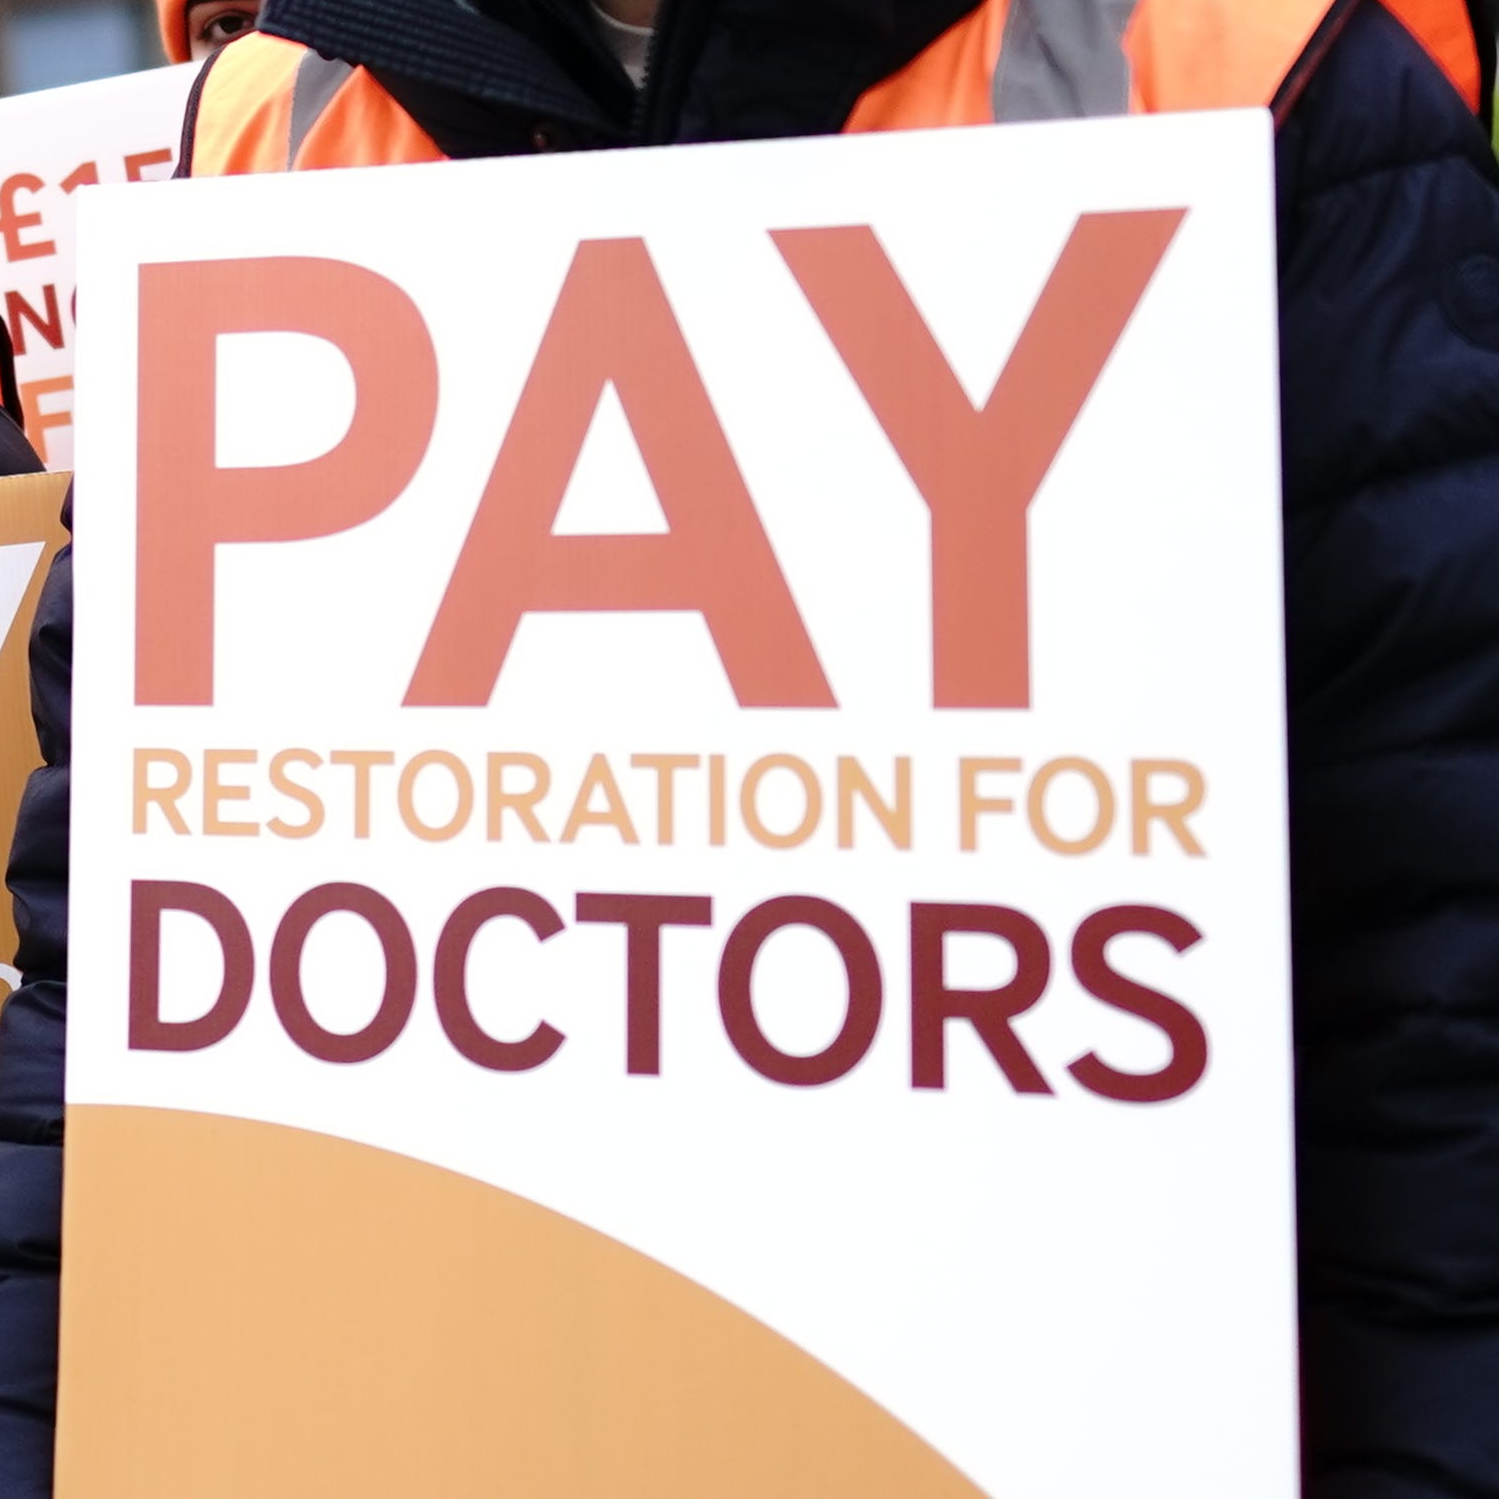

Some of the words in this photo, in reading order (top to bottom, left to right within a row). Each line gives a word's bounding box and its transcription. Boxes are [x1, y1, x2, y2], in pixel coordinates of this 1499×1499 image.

[134, 205, 1190, 710] PAY
[130, 747, 913, 852] RESTORATION
[958, 755, 1208, 857] FOR
[128, 878, 1209, 1105] DOCTORS
